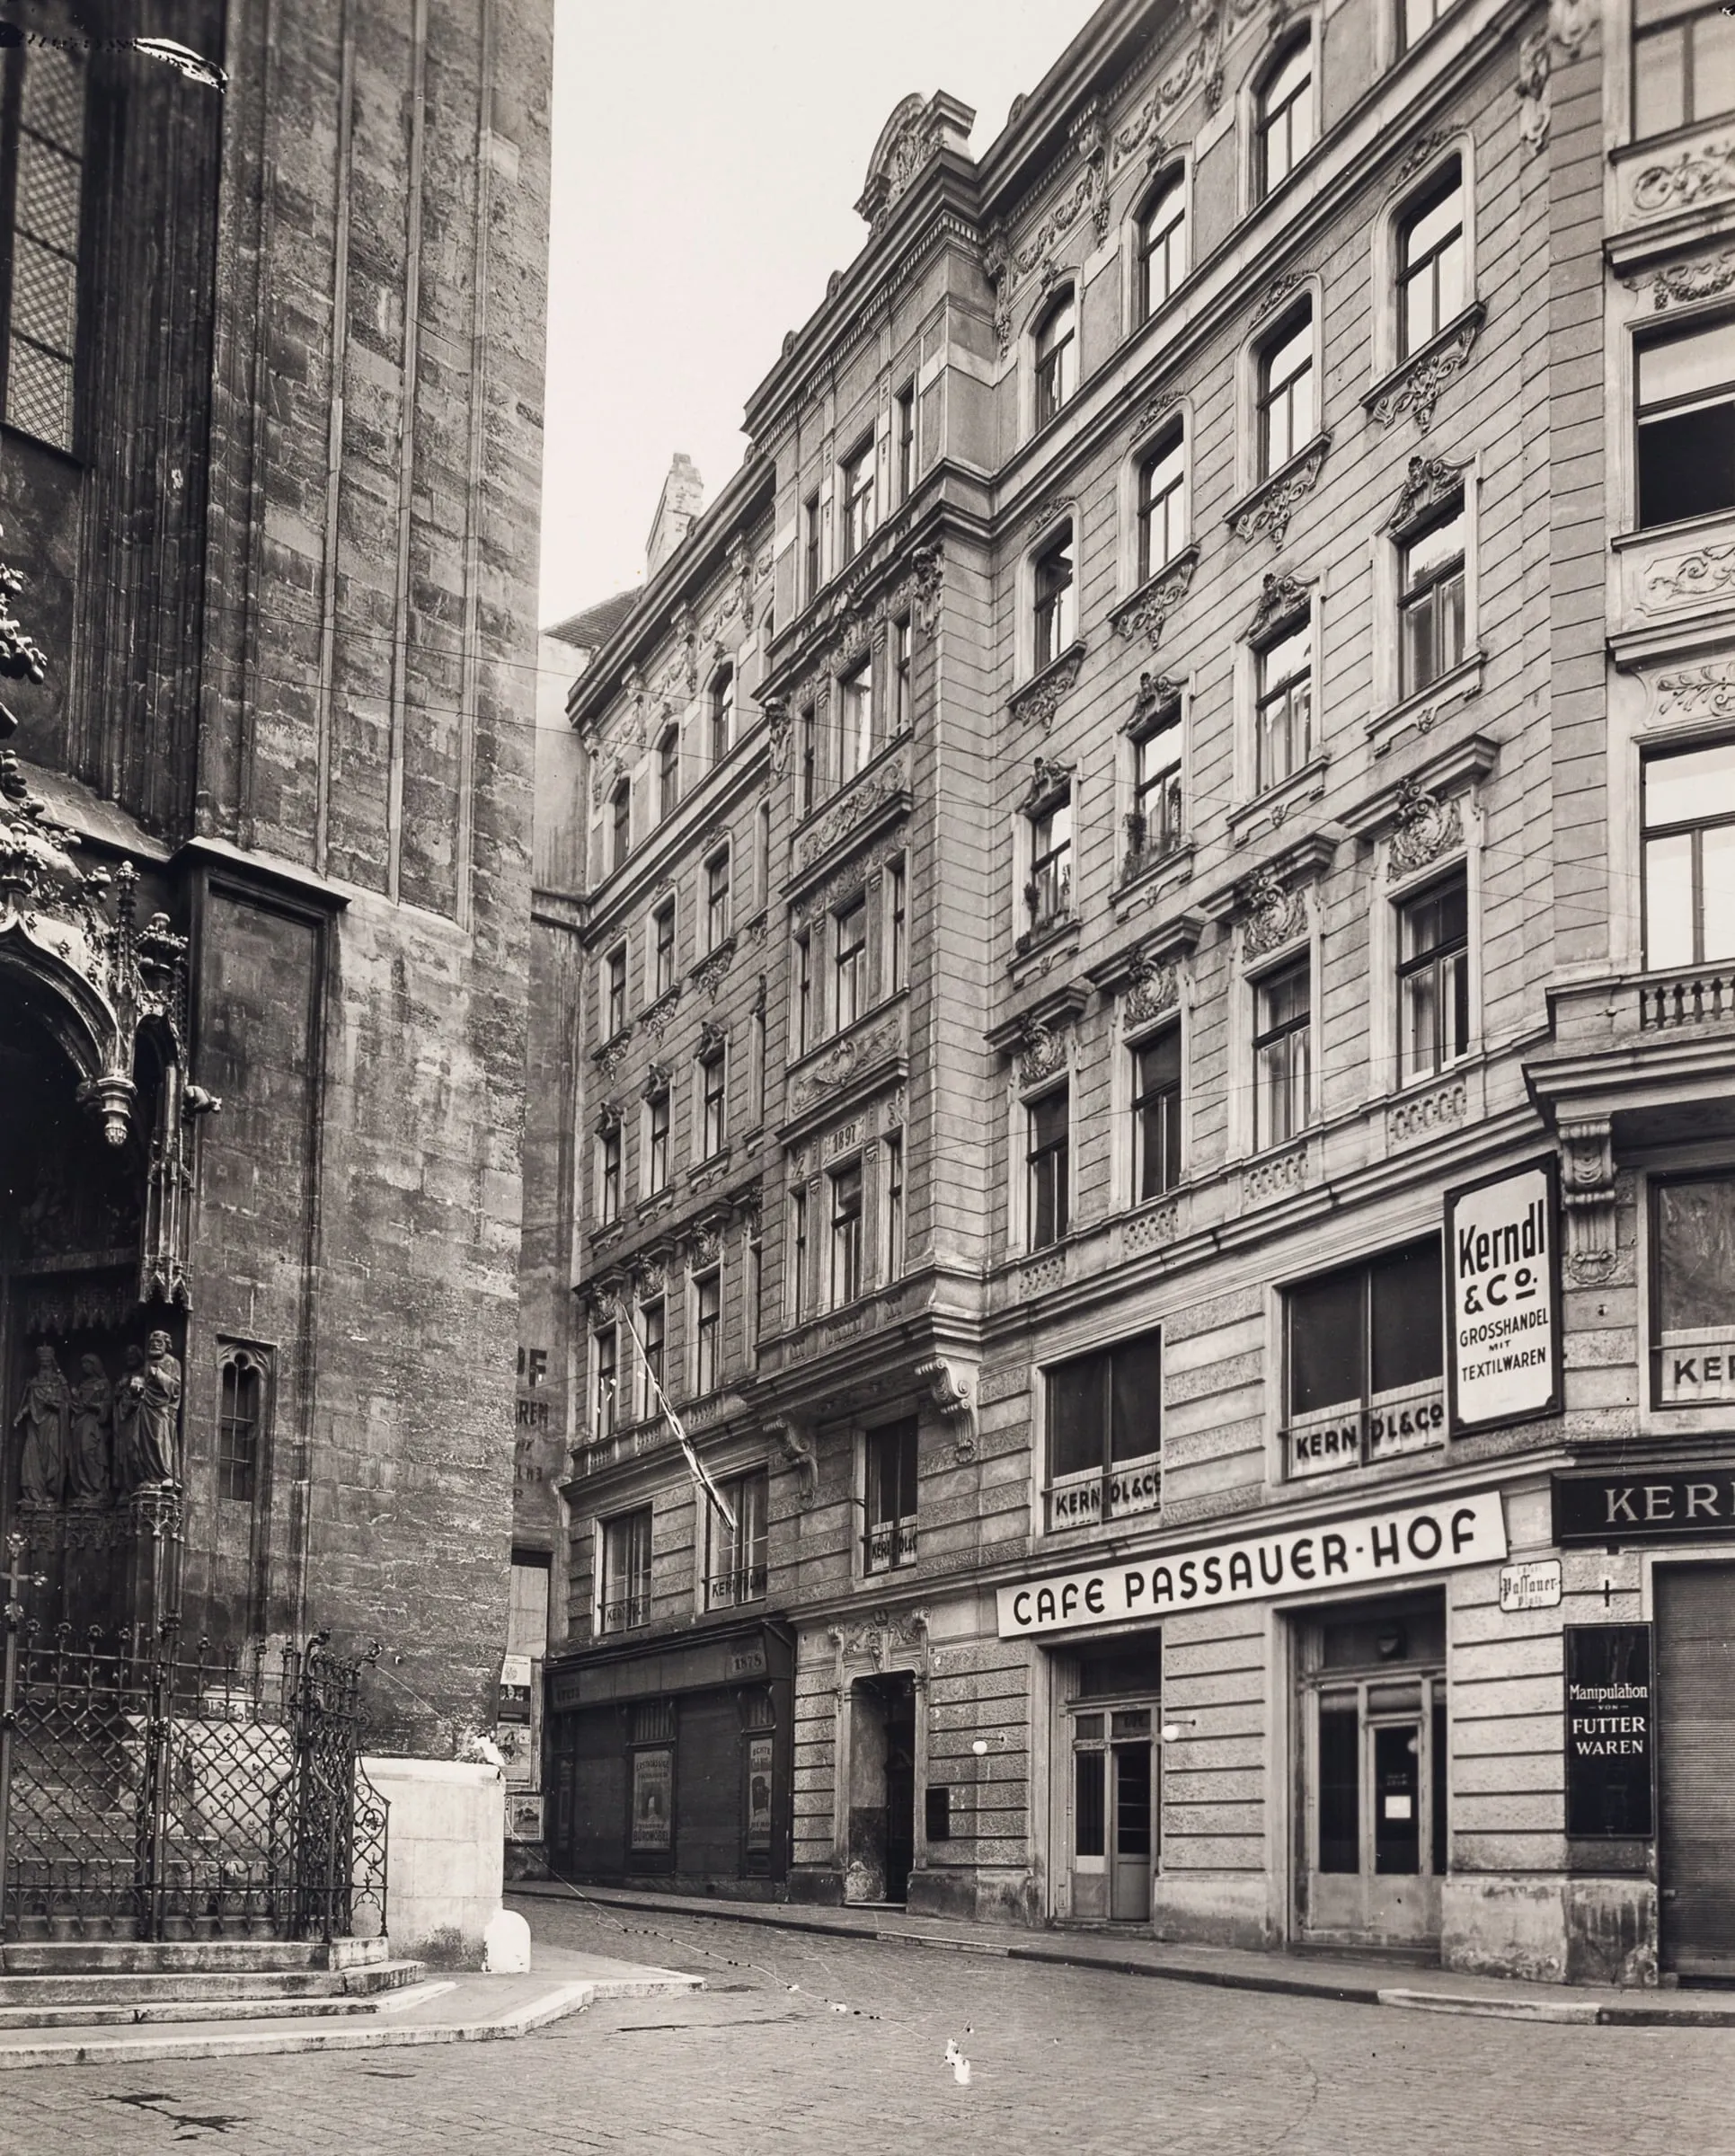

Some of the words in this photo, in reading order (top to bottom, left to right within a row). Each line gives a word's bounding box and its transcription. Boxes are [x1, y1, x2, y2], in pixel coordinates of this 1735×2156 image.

[833, 1124, 856, 1153] 1897
[1458, 1198, 1545, 1280] Kerndl
[1459, 1307, 1549, 1348] GROSSHANDEL
[1488, 1339, 1512, 1352] MIT
[1461, 1347, 1546, 1383] TEXTILWAREN
[1604, 1481, 1735, 1524] KER
[1014, 1577, 1105, 1626] CAFE
[1569, 1682, 1649, 1703] Manipulation
[1572, 1716, 1646, 1735] FUTTER
[1576, 1739, 1644, 1755] WAREN
